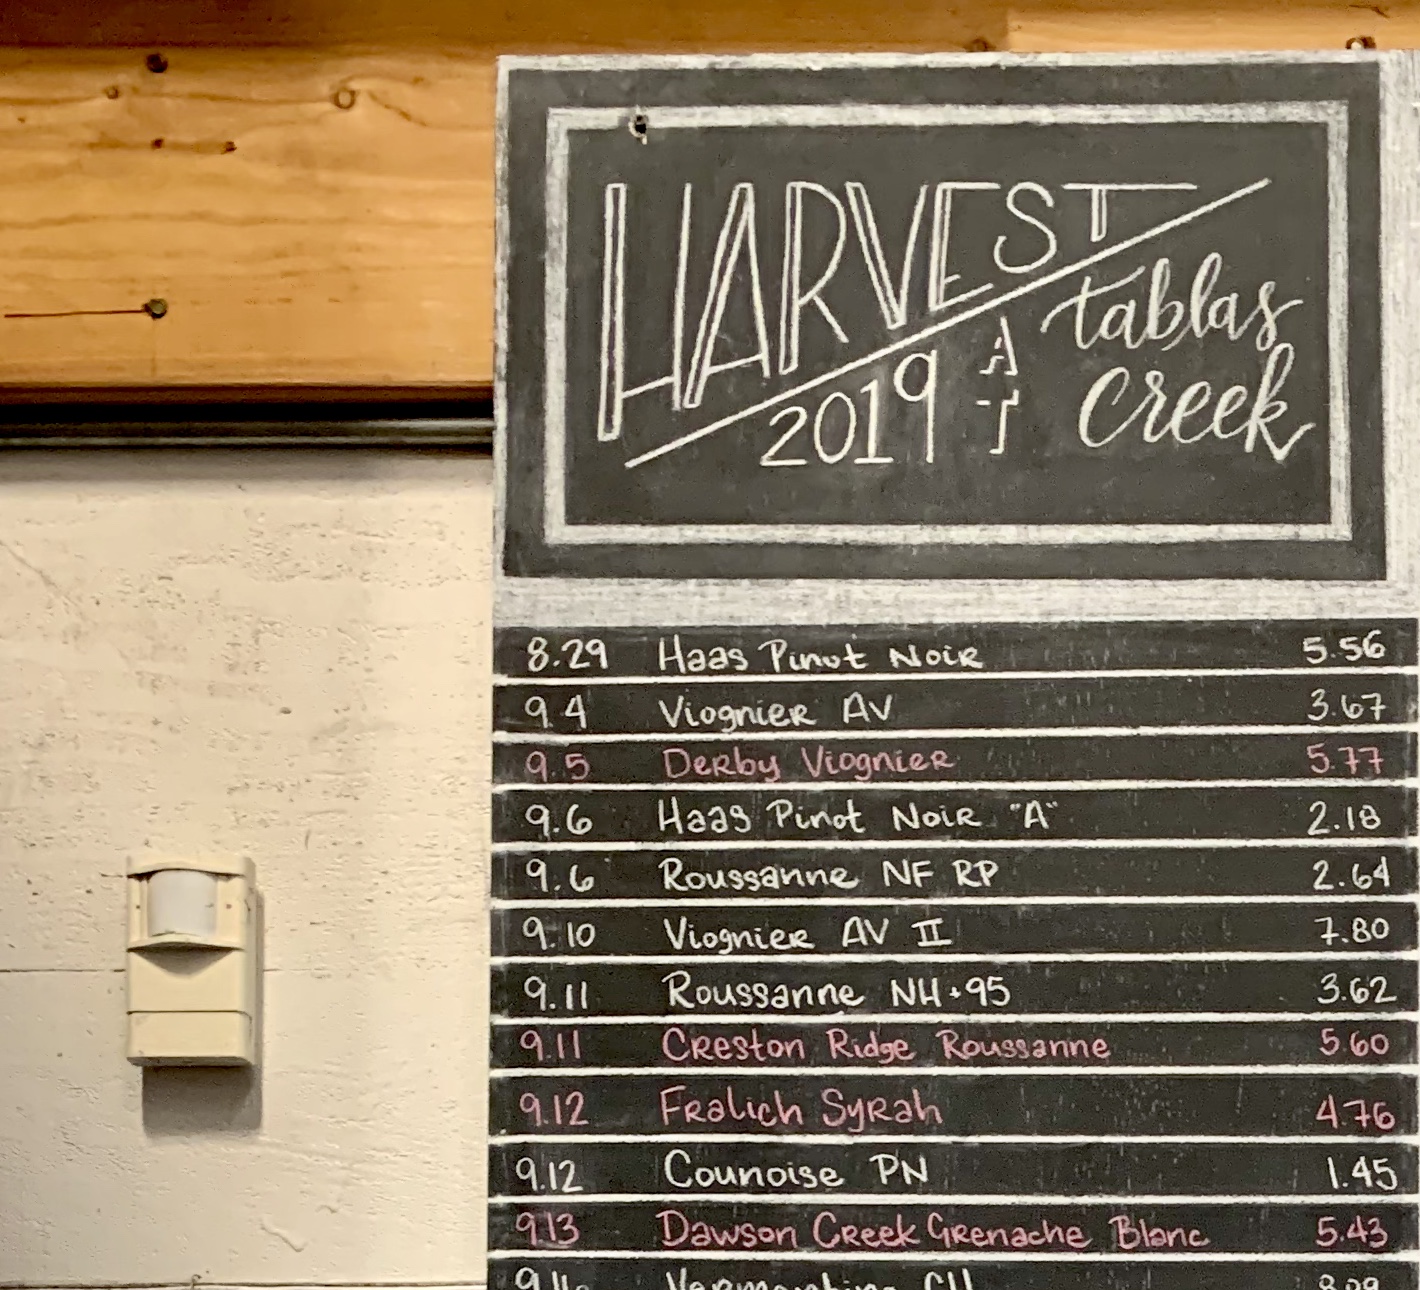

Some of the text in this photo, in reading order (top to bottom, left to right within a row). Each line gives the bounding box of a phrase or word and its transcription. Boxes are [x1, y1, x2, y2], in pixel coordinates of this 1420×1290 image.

[598, 182, 1197, 440] HARVEST
[761, 350, 935, 465] 2019
[525, 695, 586, 728] 9.4
[844, 693, 892, 723] AV
[1308, 689, 1385, 720] 3.67
[526, 804, 592, 837] 9.6
[659, 797, 751, 834] Haas
[766, 799, 865, 833] Pinot
[1308, 801, 1380, 835] 2.18
[526, 856, 1389, 892] 9.6 Roussanne NF RP 2.64
[520, 1092, 588, 1126] 9.12
[1316, 1095, 1395, 1129] 4.76
[516, 1149, 1397, 1192] 9.12 Counoise PN 1.45
[516, 1212, 579, 1248] 9.13
[657, 1210, 797, 1247] Dawson
[1112, 1215, 1210, 1249] Blanc
[1316, 1216, 1387, 1248] 5.43
